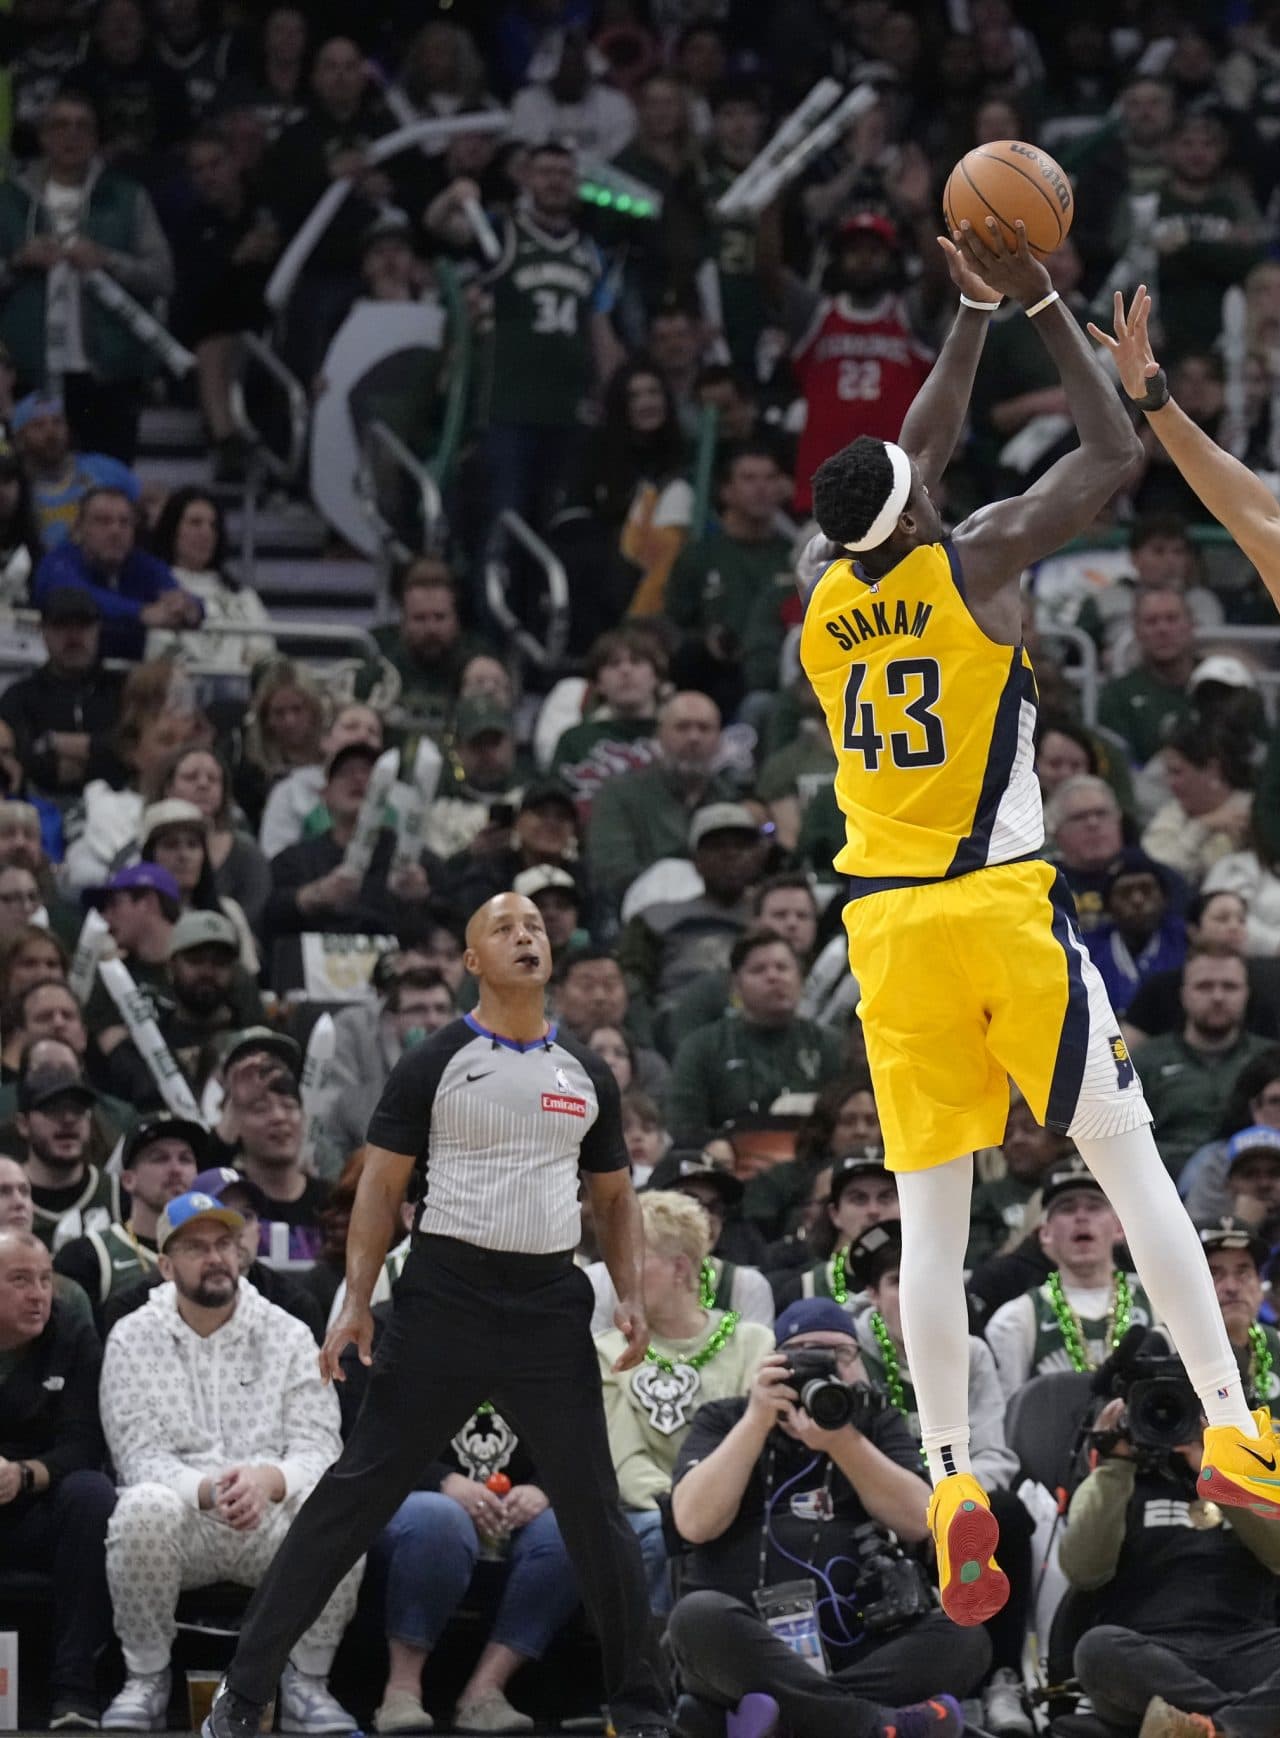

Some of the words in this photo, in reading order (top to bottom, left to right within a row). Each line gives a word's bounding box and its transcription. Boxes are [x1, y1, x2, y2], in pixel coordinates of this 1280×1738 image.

[532, 289, 578, 335] 34
[825, 599, 933, 651] SIAKAM
[843, 657, 947, 771] 43
[542, 1096, 586, 1113] Emirates
